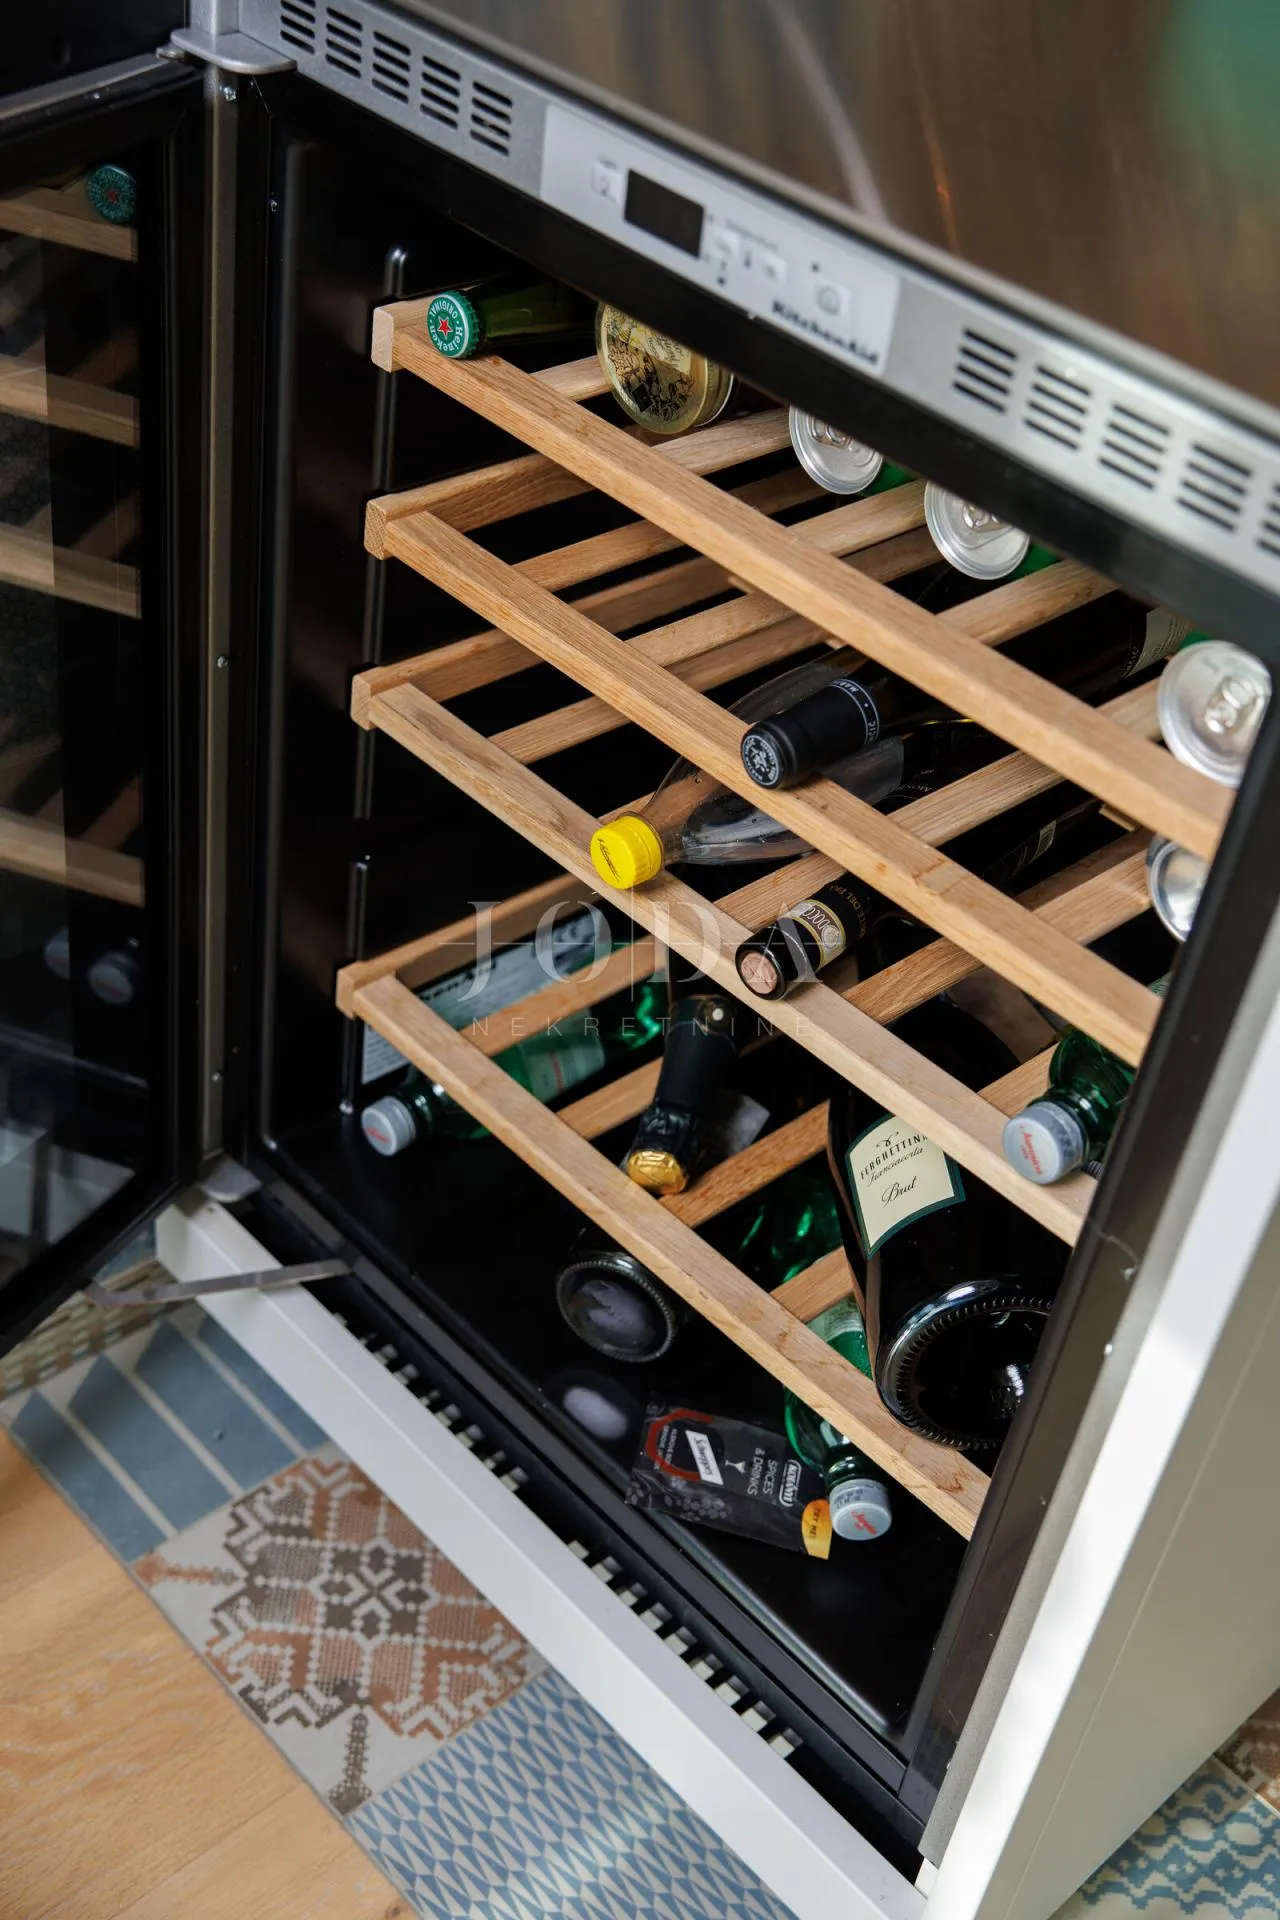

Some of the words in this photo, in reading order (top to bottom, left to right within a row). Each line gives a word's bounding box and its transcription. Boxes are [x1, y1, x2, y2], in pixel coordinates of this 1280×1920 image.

[429, 300, 458, 319] ORIGINAL
[429, 325, 463, 352] Heineken
[770, 299, 881, 366] KitchenAid
[866, 1146, 924, 1188] Franciacorta
[881, 1175, 917, 1208] Brut
[754, 1447, 766, 1456] &
[747, 1457, 764, 1496] DRINKS
[762, 1459, 778, 1495] SPICES
